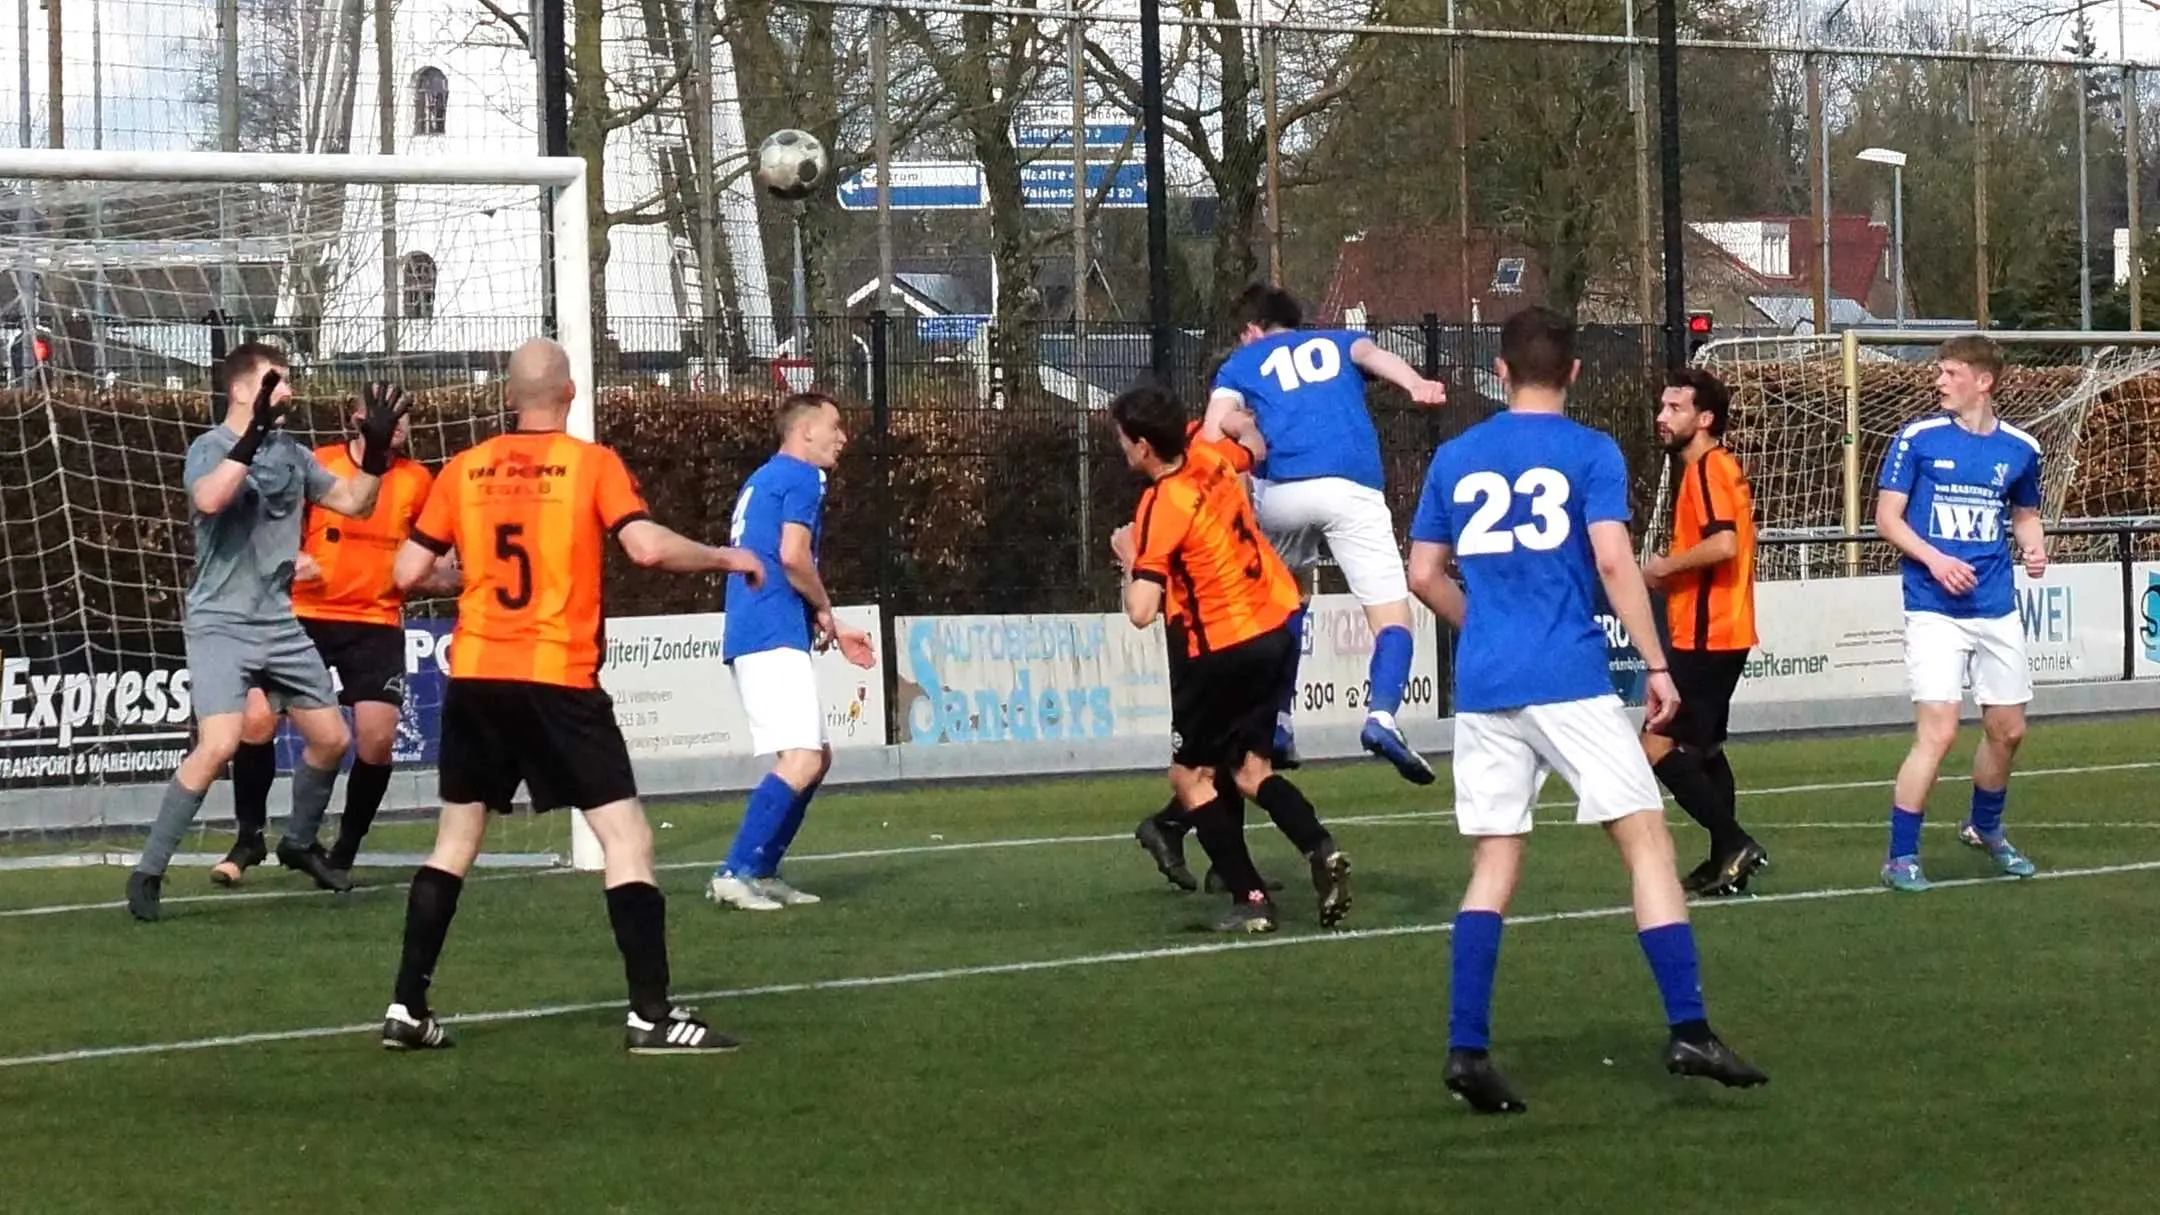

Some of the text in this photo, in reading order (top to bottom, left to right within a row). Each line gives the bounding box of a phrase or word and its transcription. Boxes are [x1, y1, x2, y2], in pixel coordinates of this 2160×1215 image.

[1118, 187, 1133, 198] 20
[1260, 338, 1341, 392] 10
[1453, 467, 1570, 556] 23
[495, 522, 533, 611] 5
[1, 656, 192, 748] Express
[909, 620, 1115, 746] Sanders
[0, 755, 73, 779] TRANSPORT
[75, 753, 86, 775] &
